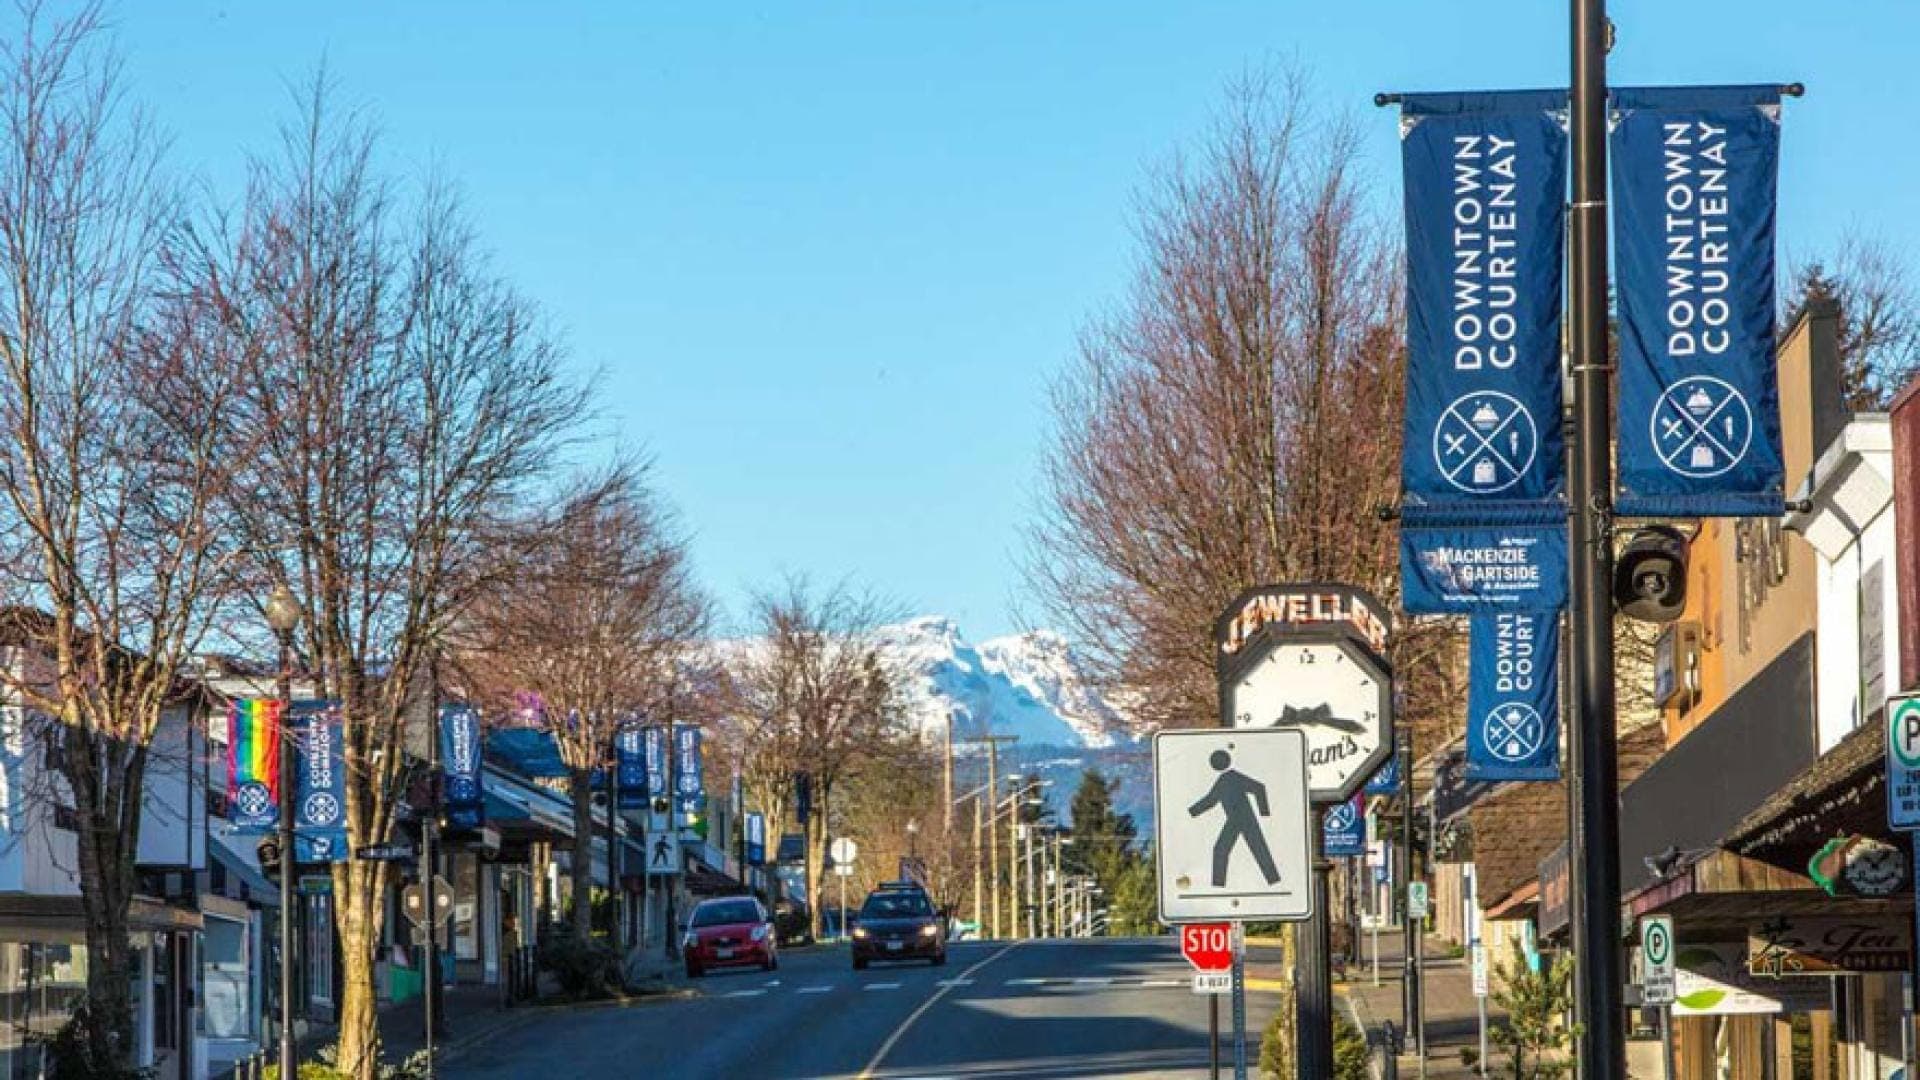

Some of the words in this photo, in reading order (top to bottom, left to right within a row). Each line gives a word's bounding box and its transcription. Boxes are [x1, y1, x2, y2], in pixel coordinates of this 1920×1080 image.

[1454, 136, 1482, 371] DOWNTOWN
[1488, 134, 1517, 370] COURTENAY
[1664, 122, 1696, 357] DOWNTOWN
[1699, 121, 1730, 355] COURTENAY
[1438, 547, 1528, 565] MACKENZIE
[1462, 565, 1540, 582] GARTSIDE
[1308, 735, 1358, 766] am's
[1187, 929, 1231, 952] STO
[1653, 933, 1662, 954] P
